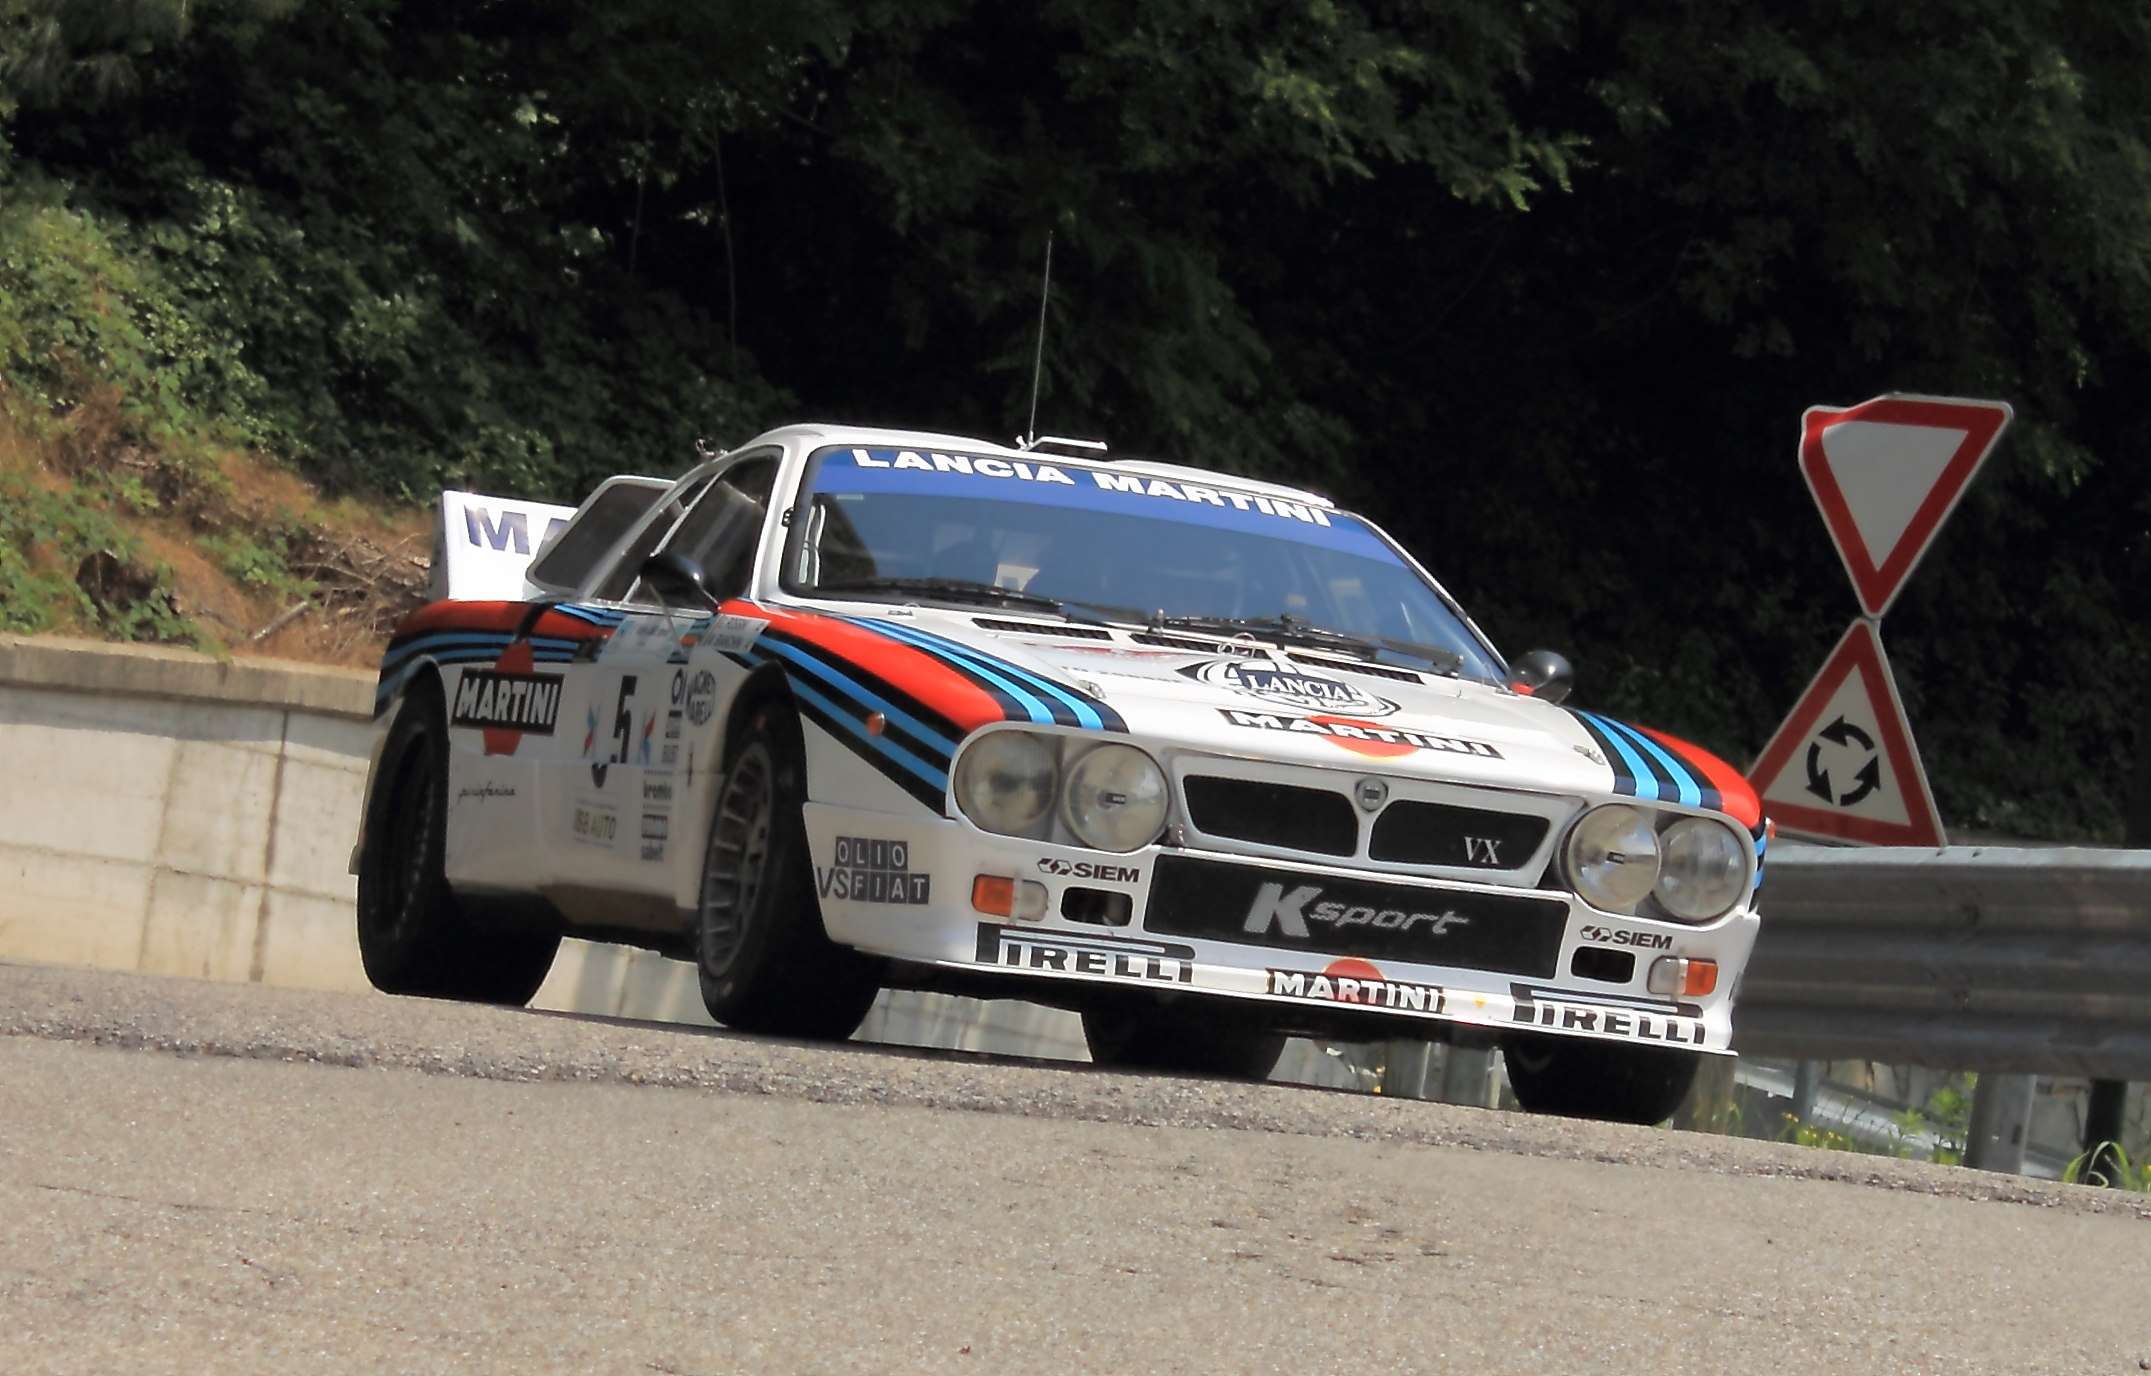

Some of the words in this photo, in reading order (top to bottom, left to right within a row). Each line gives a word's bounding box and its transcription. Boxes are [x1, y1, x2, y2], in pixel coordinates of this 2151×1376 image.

[852, 447, 1074, 486] LANCIA
[1093, 471, 1331, 527] MARTINI
[455, 677, 559, 726] MARTINI
[1247, 675, 1347, 701] LANCIA
[591, 674, 638, 788] 5
[1233, 709, 1492, 756] MARTINI
[836, 839, 907, 869] OLIO
[1073, 861, 1140, 884] SIEM
[1463, 836, 1501, 866] VX
[975, 922, 1197, 983] PIRELLI
[1613, 929, 1673, 951] SIEM
[1272, 971, 1442, 1013] MARTINI
[1510, 982, 1706, 1045] PIRELLI
